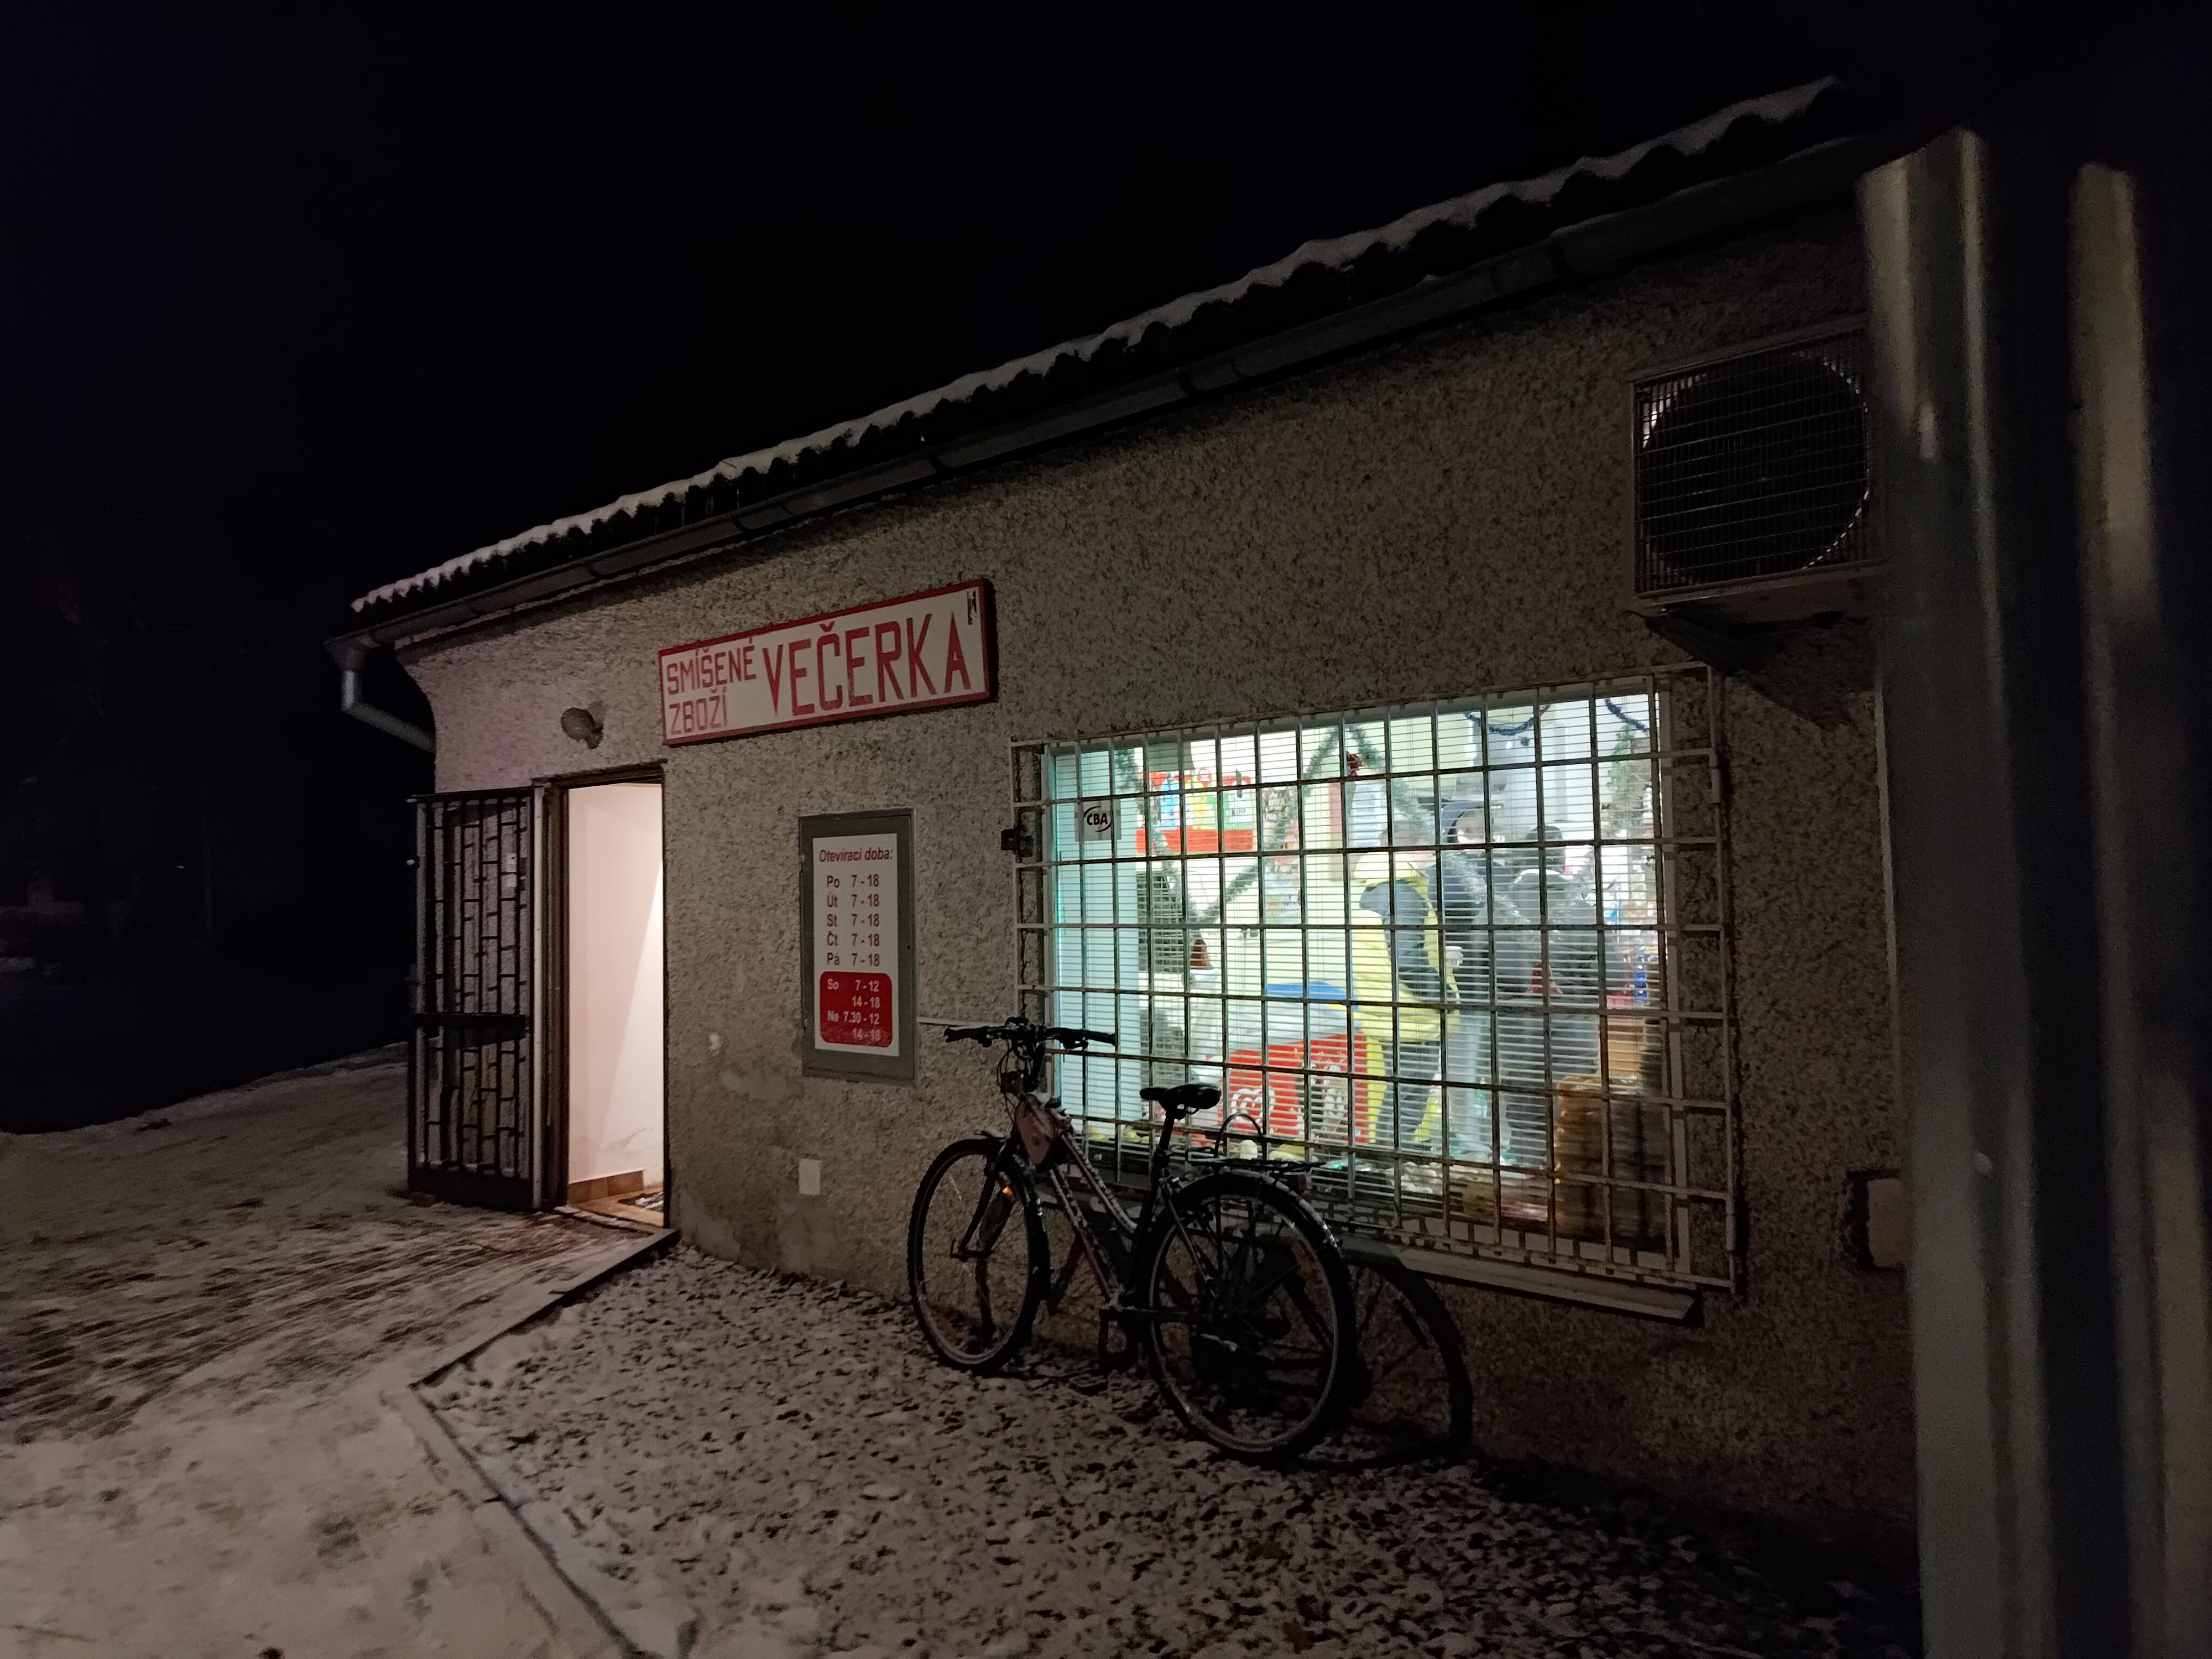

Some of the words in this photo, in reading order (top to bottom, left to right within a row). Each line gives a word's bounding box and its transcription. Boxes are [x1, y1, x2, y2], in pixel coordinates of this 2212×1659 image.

[667, 637, 757, 695] SMÍŠENÉ
[762, 611, 972, 716] VEČERKA
[668, 686, 728, 735] ZBOŽÍ
[1087, 813, 1108, 825] CBA
[820, 847, 863, 862] Otevírací
[865, 847, 894, 860] doba:
[827, 875, 840, 888] Po
[827, 892, 838, 907] Út
[827, 914, 838, 927] St
[826, 931, 838, 946] Čt
[827, 952, 840, 965] Pá
[827, 978, 839, 990] So
[827, 1010, 839, 1022] Ne
